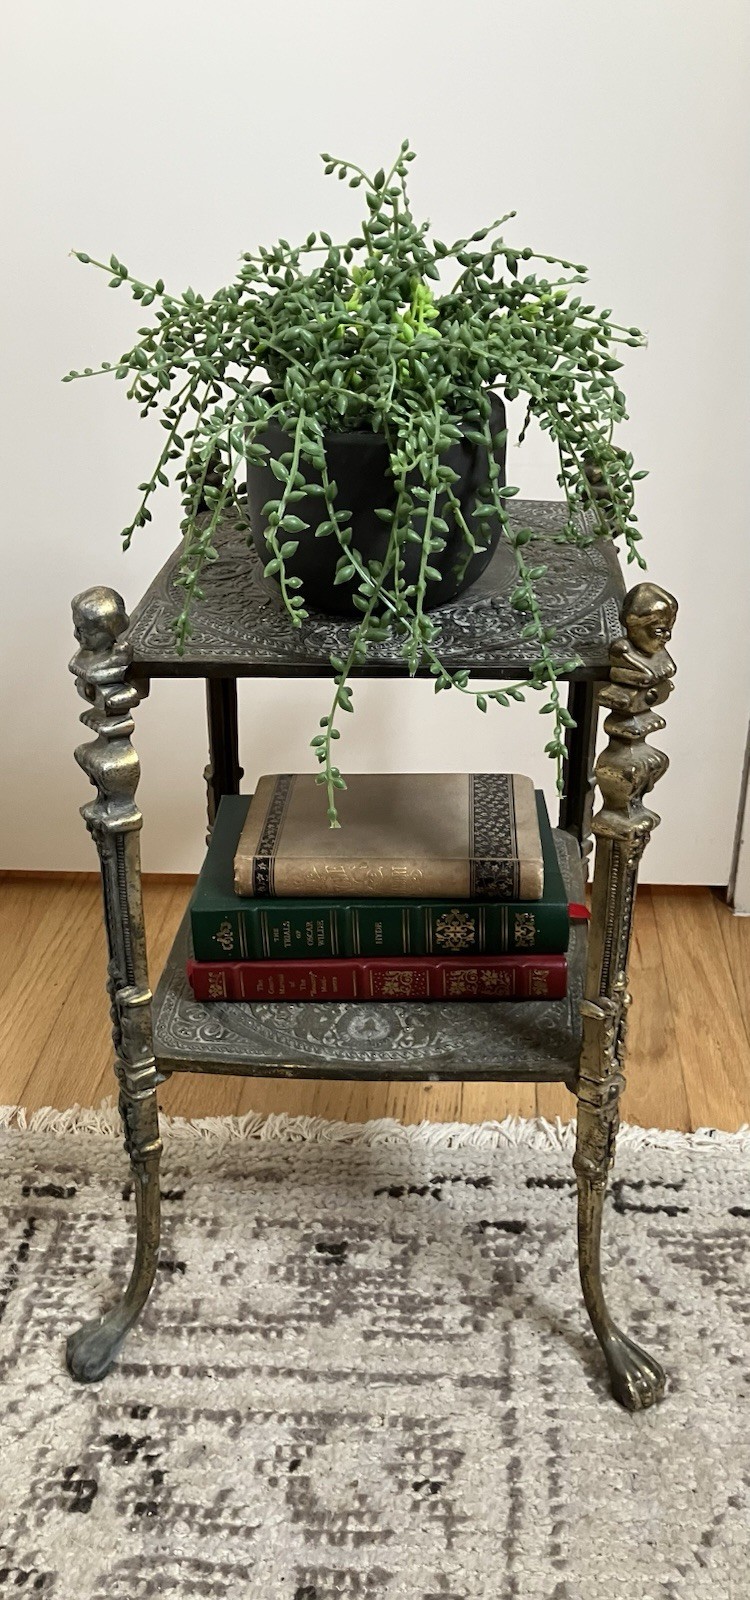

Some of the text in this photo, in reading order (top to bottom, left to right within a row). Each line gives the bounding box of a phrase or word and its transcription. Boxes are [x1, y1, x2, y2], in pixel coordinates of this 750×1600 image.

[282, 921, 291, 948] TRIALS
[306, 921, 314, 946] OSCAR
[317, 920, 325, 946] WILDE
[374, 921, 382, 945] HYDE
